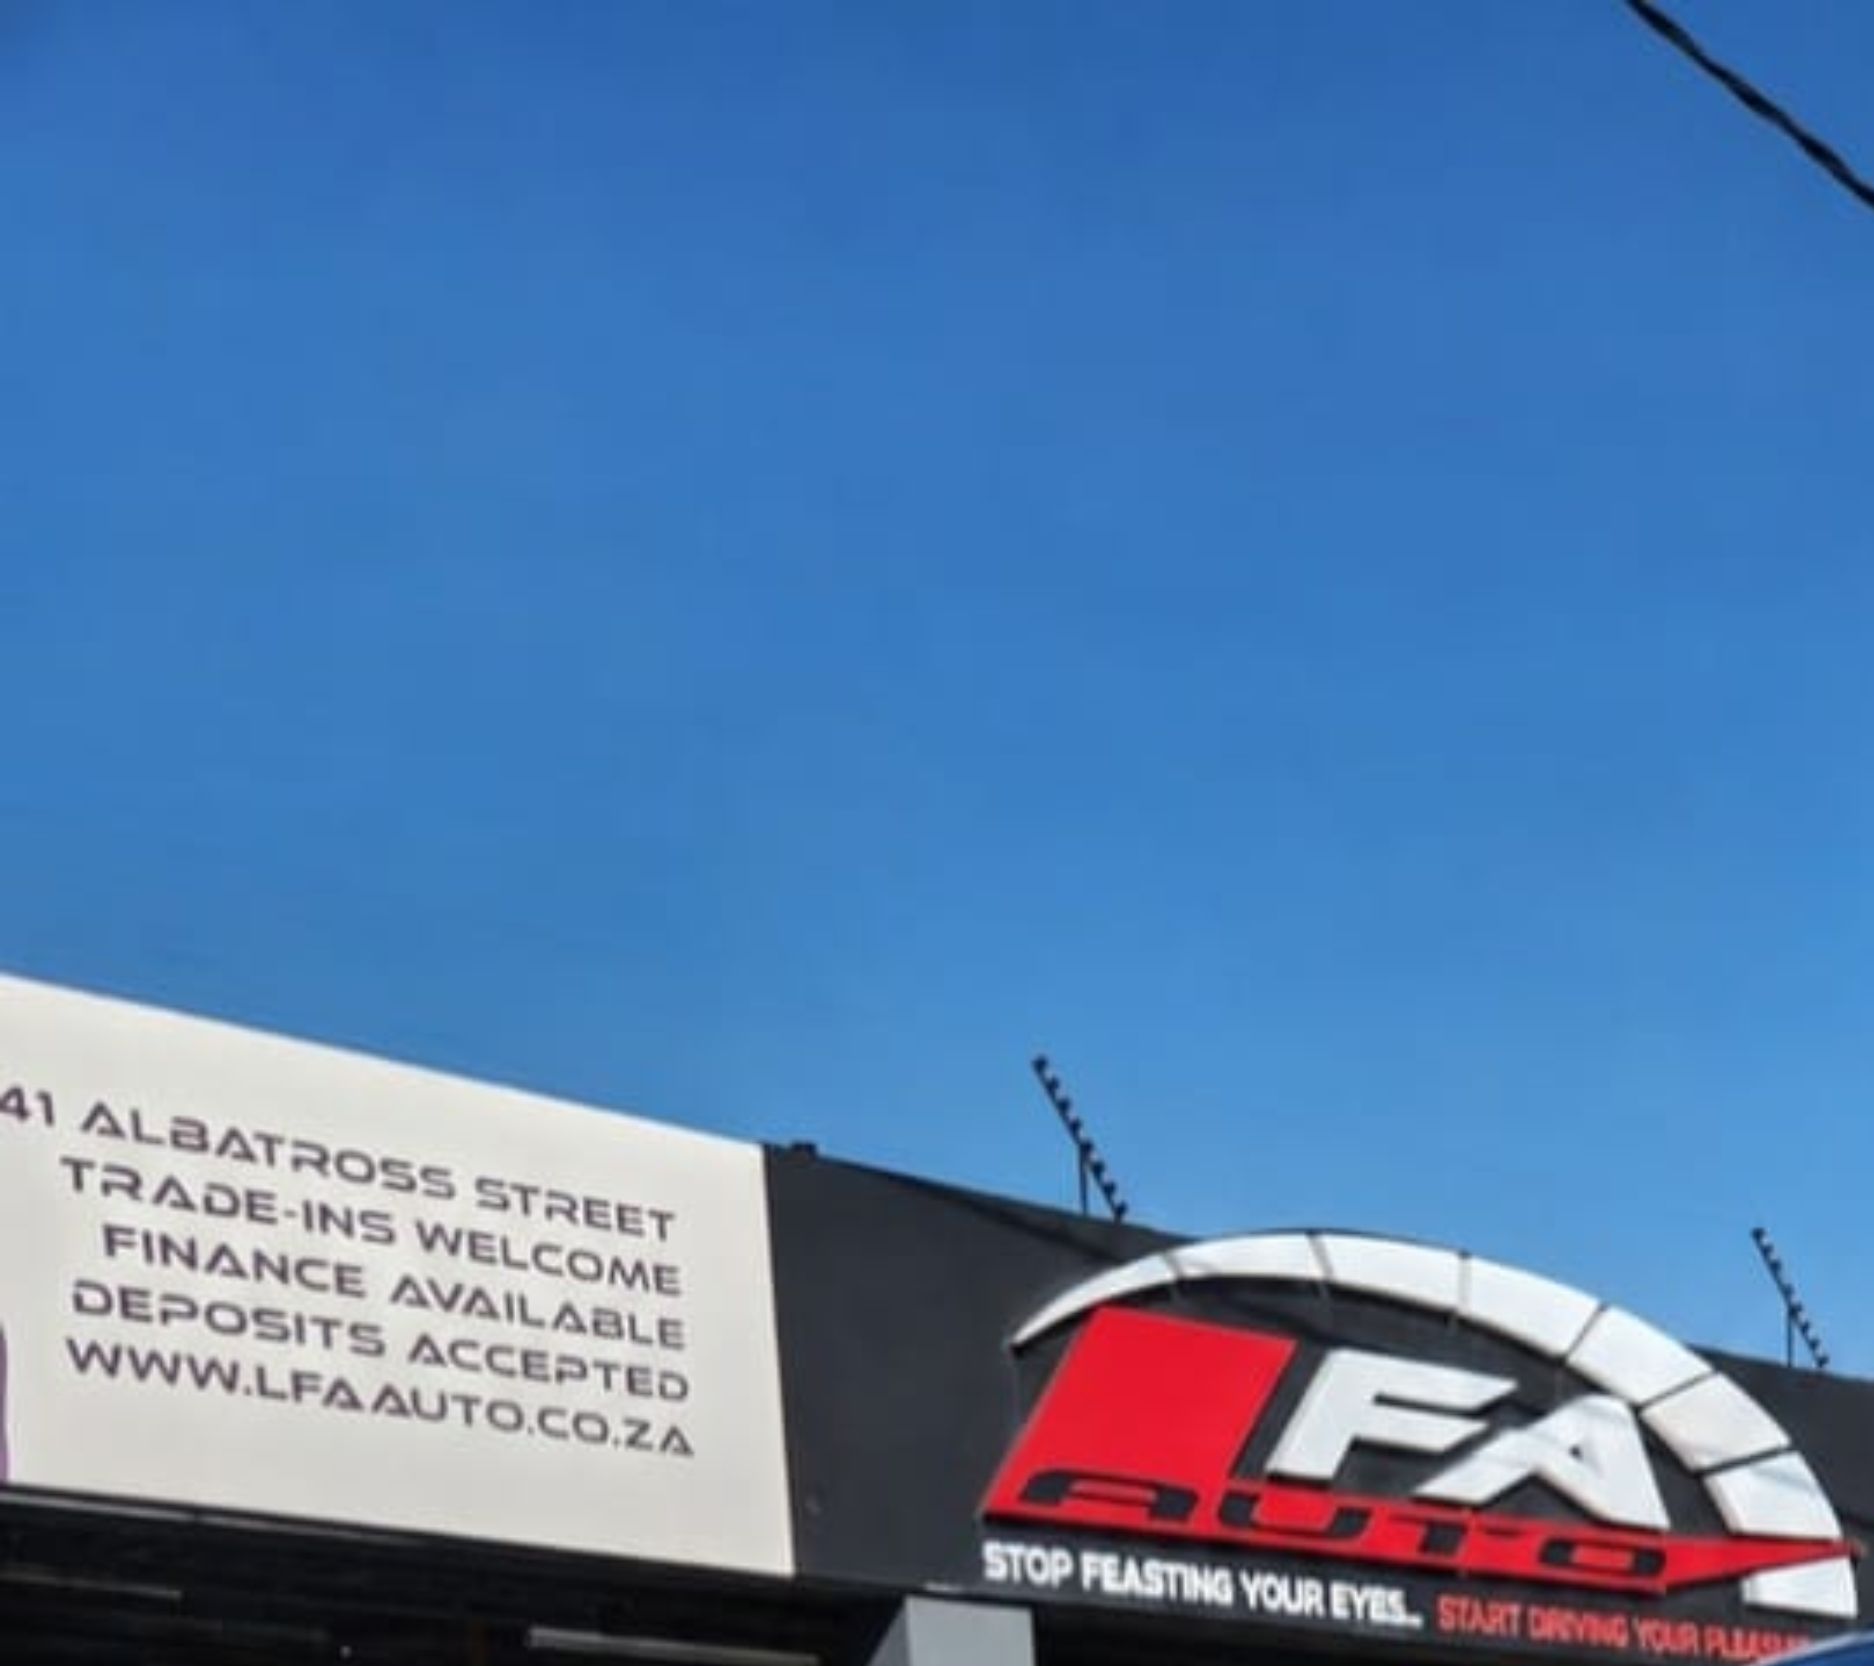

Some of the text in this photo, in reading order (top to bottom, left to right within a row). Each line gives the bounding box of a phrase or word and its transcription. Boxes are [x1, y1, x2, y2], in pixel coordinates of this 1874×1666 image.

[0, 1085, 676, 1241] 41 ALBATROSS STREET
[60, 1156, 681, 1296] TRADE-INS WELCOME
[102, 1223, 686, 1351] FINANCE AVAILABLE
[65, 1337, 694, 1457] WWW.LFAAUTO.CO.ZA
[71, 1279, 689, 1402] DEPOSITS ACCEPTED
[1018, 1469, 1667, 1580] AUTO
[982, 1540, 1074, 1588] STOP
[1079, 1550, 1235, 1608] FEASTING
[1239, 1570, 1326, 1617] YOUR
[1438, 1595, 1522, 1637] START
[1528, 1606, 1630, 1649] DRIVING
[1634, 1618, 1700, 1655] YOUR
